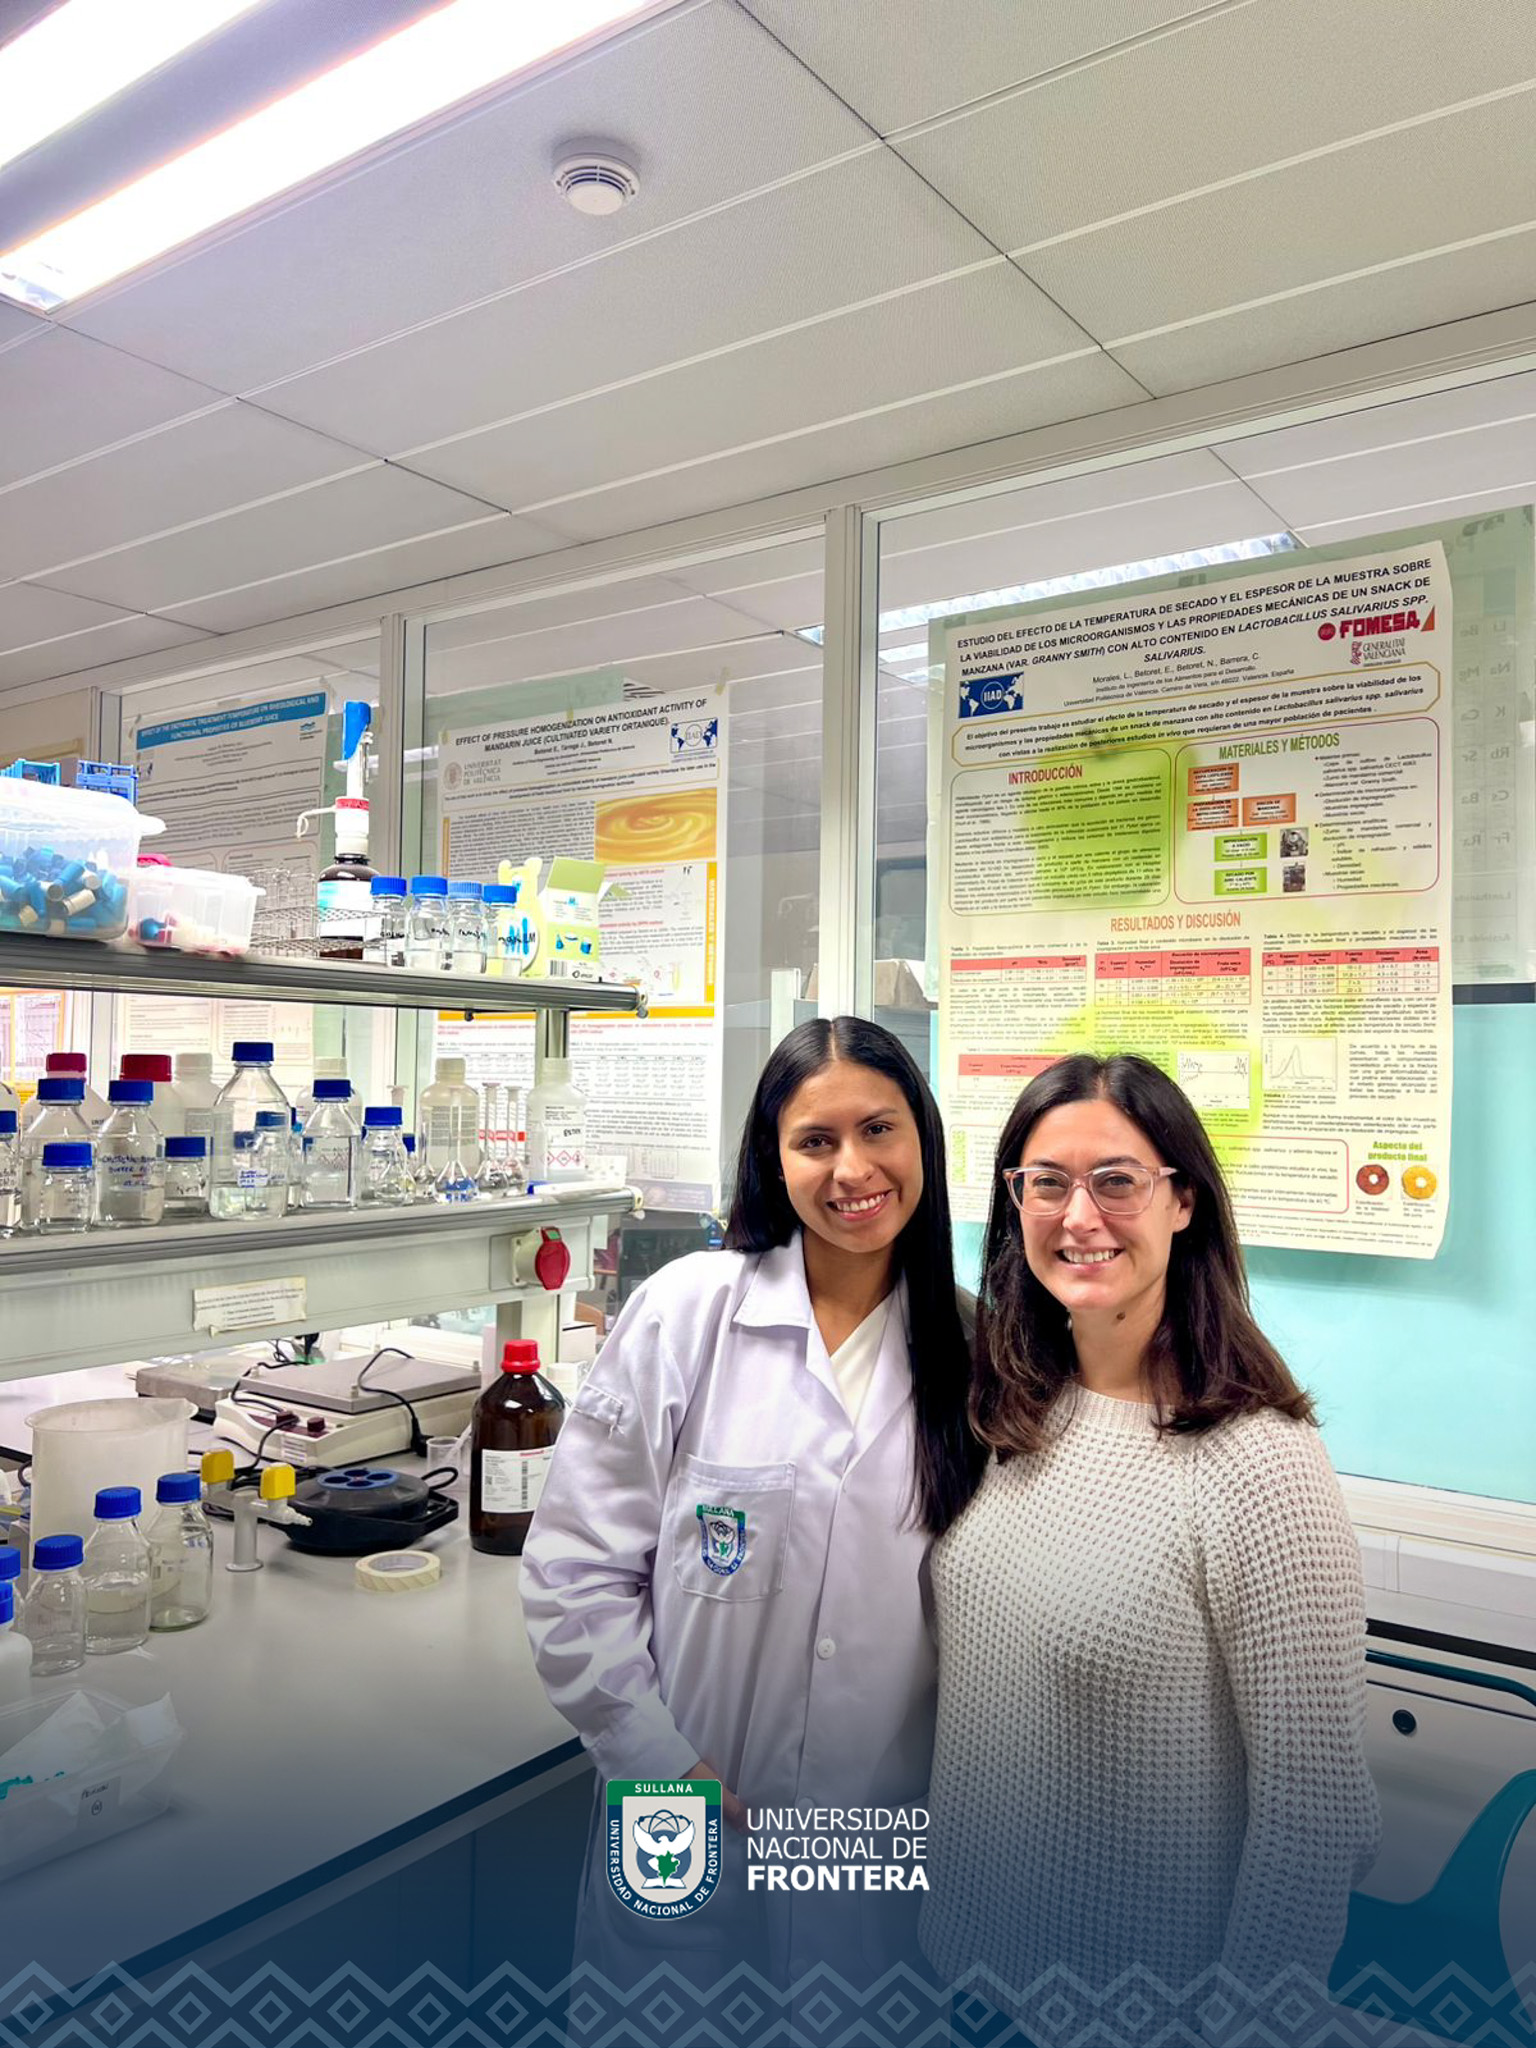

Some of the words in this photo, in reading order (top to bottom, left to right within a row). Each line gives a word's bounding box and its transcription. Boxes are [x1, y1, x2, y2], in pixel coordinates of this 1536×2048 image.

[958, 634, 995, 648] ESTUDIO
[997, 632, 1014, 642] DEL
[1016, 625, 1053, 638] EFECTO
[1054, 622, 1068, 631] DE
[1070, 620, 1082, 629] LA
[1084, 608, 1156, 626] TEMPERATURA
[1159, 604, 1174, 614] DE
[1175, 597, 1218, 612] SECADO
[1220, 595, 1227, 603] Y
[1230, 592, 1242, 602] EL
[1246, 582, 1295, 599] ESPESOR
[1298, 580, 1312, 590] DE
[1316, 576, 1330, 586] LA
[1334, 568, 1390, 584] MUESTRA
[1393, 558, 1432, 574] SOBRE
[960, 654, 971, 662] LA
[974, 645, 1021, 660] VIABILIDAD
[1024, 642, 1036, 652] DE
[1038, 638, 1057, 649] LOS
[1060, 622, 1155, 646] MICROORGANISMOS
[1158, 622, 1164, 630] Y
[1167, 618, 1186, 628] LAS
[1189, 606, 1262, 624] PROPIEDADES
[1265, 592, 1329, 612] MECÁNICAS
[1332, 590, 1348, 600] DE
[1352, 588, 1368, 598] UN
[1370, 580, 1410, 594] SNACK
[1414, 576, 1430, 588] DE
[1340, 610, 1420, 639] FOMESA
[962, 662, 1004, 676] MANZANA
[1032, 652, 1072, 664] GRANNY
[1074, 646, 1105, 659] SMITH)
[1107, 642, 1128, 654] CON
[1131, 638, 1156, 649] ALTO
[1160, 628, 1218, 645] CONTENIDO
[1221, 626, 1236, 636] EN
[1238, 610, 1328, 632] LACTOBACILLUS
[1330, 600, 1399, 617] SALIVARIUS
[1402, 594, 1429, 606] SPP.
[1144, 646, 1206, 662] SALIVARIUS.
[456, 735, 480, 746] EFFECT
[482, 734, 490, 742] OF
[493, 728, 529, 740] PRESSURE
[531, 716, 594, 734] HOMOGENIZATION
[596, 715, 606, 724] ON
[608, 706, 658, 721] ANTIOXIDANT
[659, 700, 694, 714] ACTIVITY
[696, 698, 707, 708] OF
[485, 741, 520, 752] MANDARIN
[522, 736, 542, 746] JUICE
[544, 730, 588, 745] (CULTIVATED
[590, 725, 620, 736] VARIETY
[1220, 740, 1279, 760] MATERIALES
[1280, 738, 1288, 752] Y
[1290, 732, 1340, 752] MÉTODOS
[1008, 764, 1082, 784] INTRODUCCIÓN
[1110, 915, 1174, 932] RESULTADOS
[1176, 915, 1184, 928] Y
[1186, 910, 1240, 929] DISCUSIÓN
